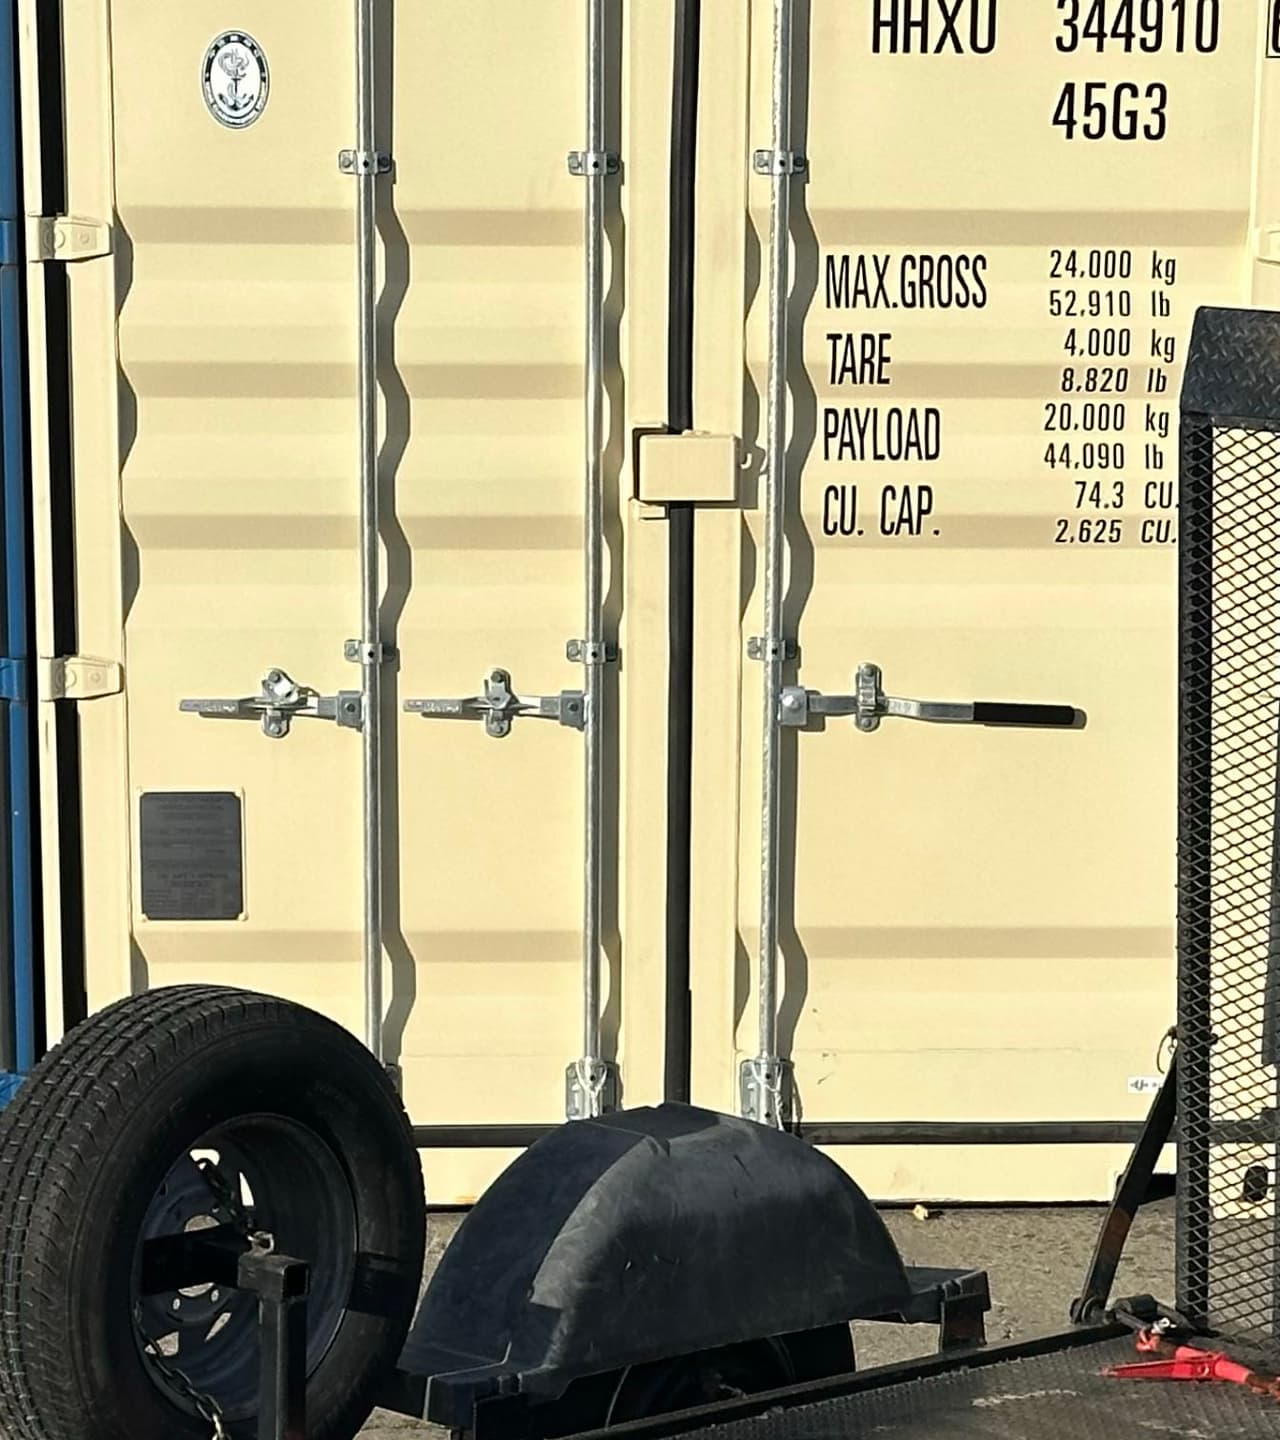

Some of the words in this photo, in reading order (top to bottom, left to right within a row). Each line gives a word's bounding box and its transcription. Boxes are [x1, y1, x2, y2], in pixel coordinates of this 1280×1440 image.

[872, 0, 997, 54] HHXU
[1056, 0, 1219, 53] 344910
[1052, 82, 1167, 140] 45G3
[826, 254, 987, 308] MAX.GROSS
[1151, 250, 1176, 286] kg
[1151, 290, 1170, 317] lb
[826, 333, 892, 385] TARE
[1151, 329, 1175, 363] kg
[1147, 368, 1167, 393] lb
[823, 407, 940, 461] PAYLOAD
[1145, 403, 1169, 438] kg
[1145, 443, 1163, 469] lb
[823, 485, 864, 536] CU.
[880, 485, 940, 536] CAP.
[1075, 481, 1124, 509] 74.3
